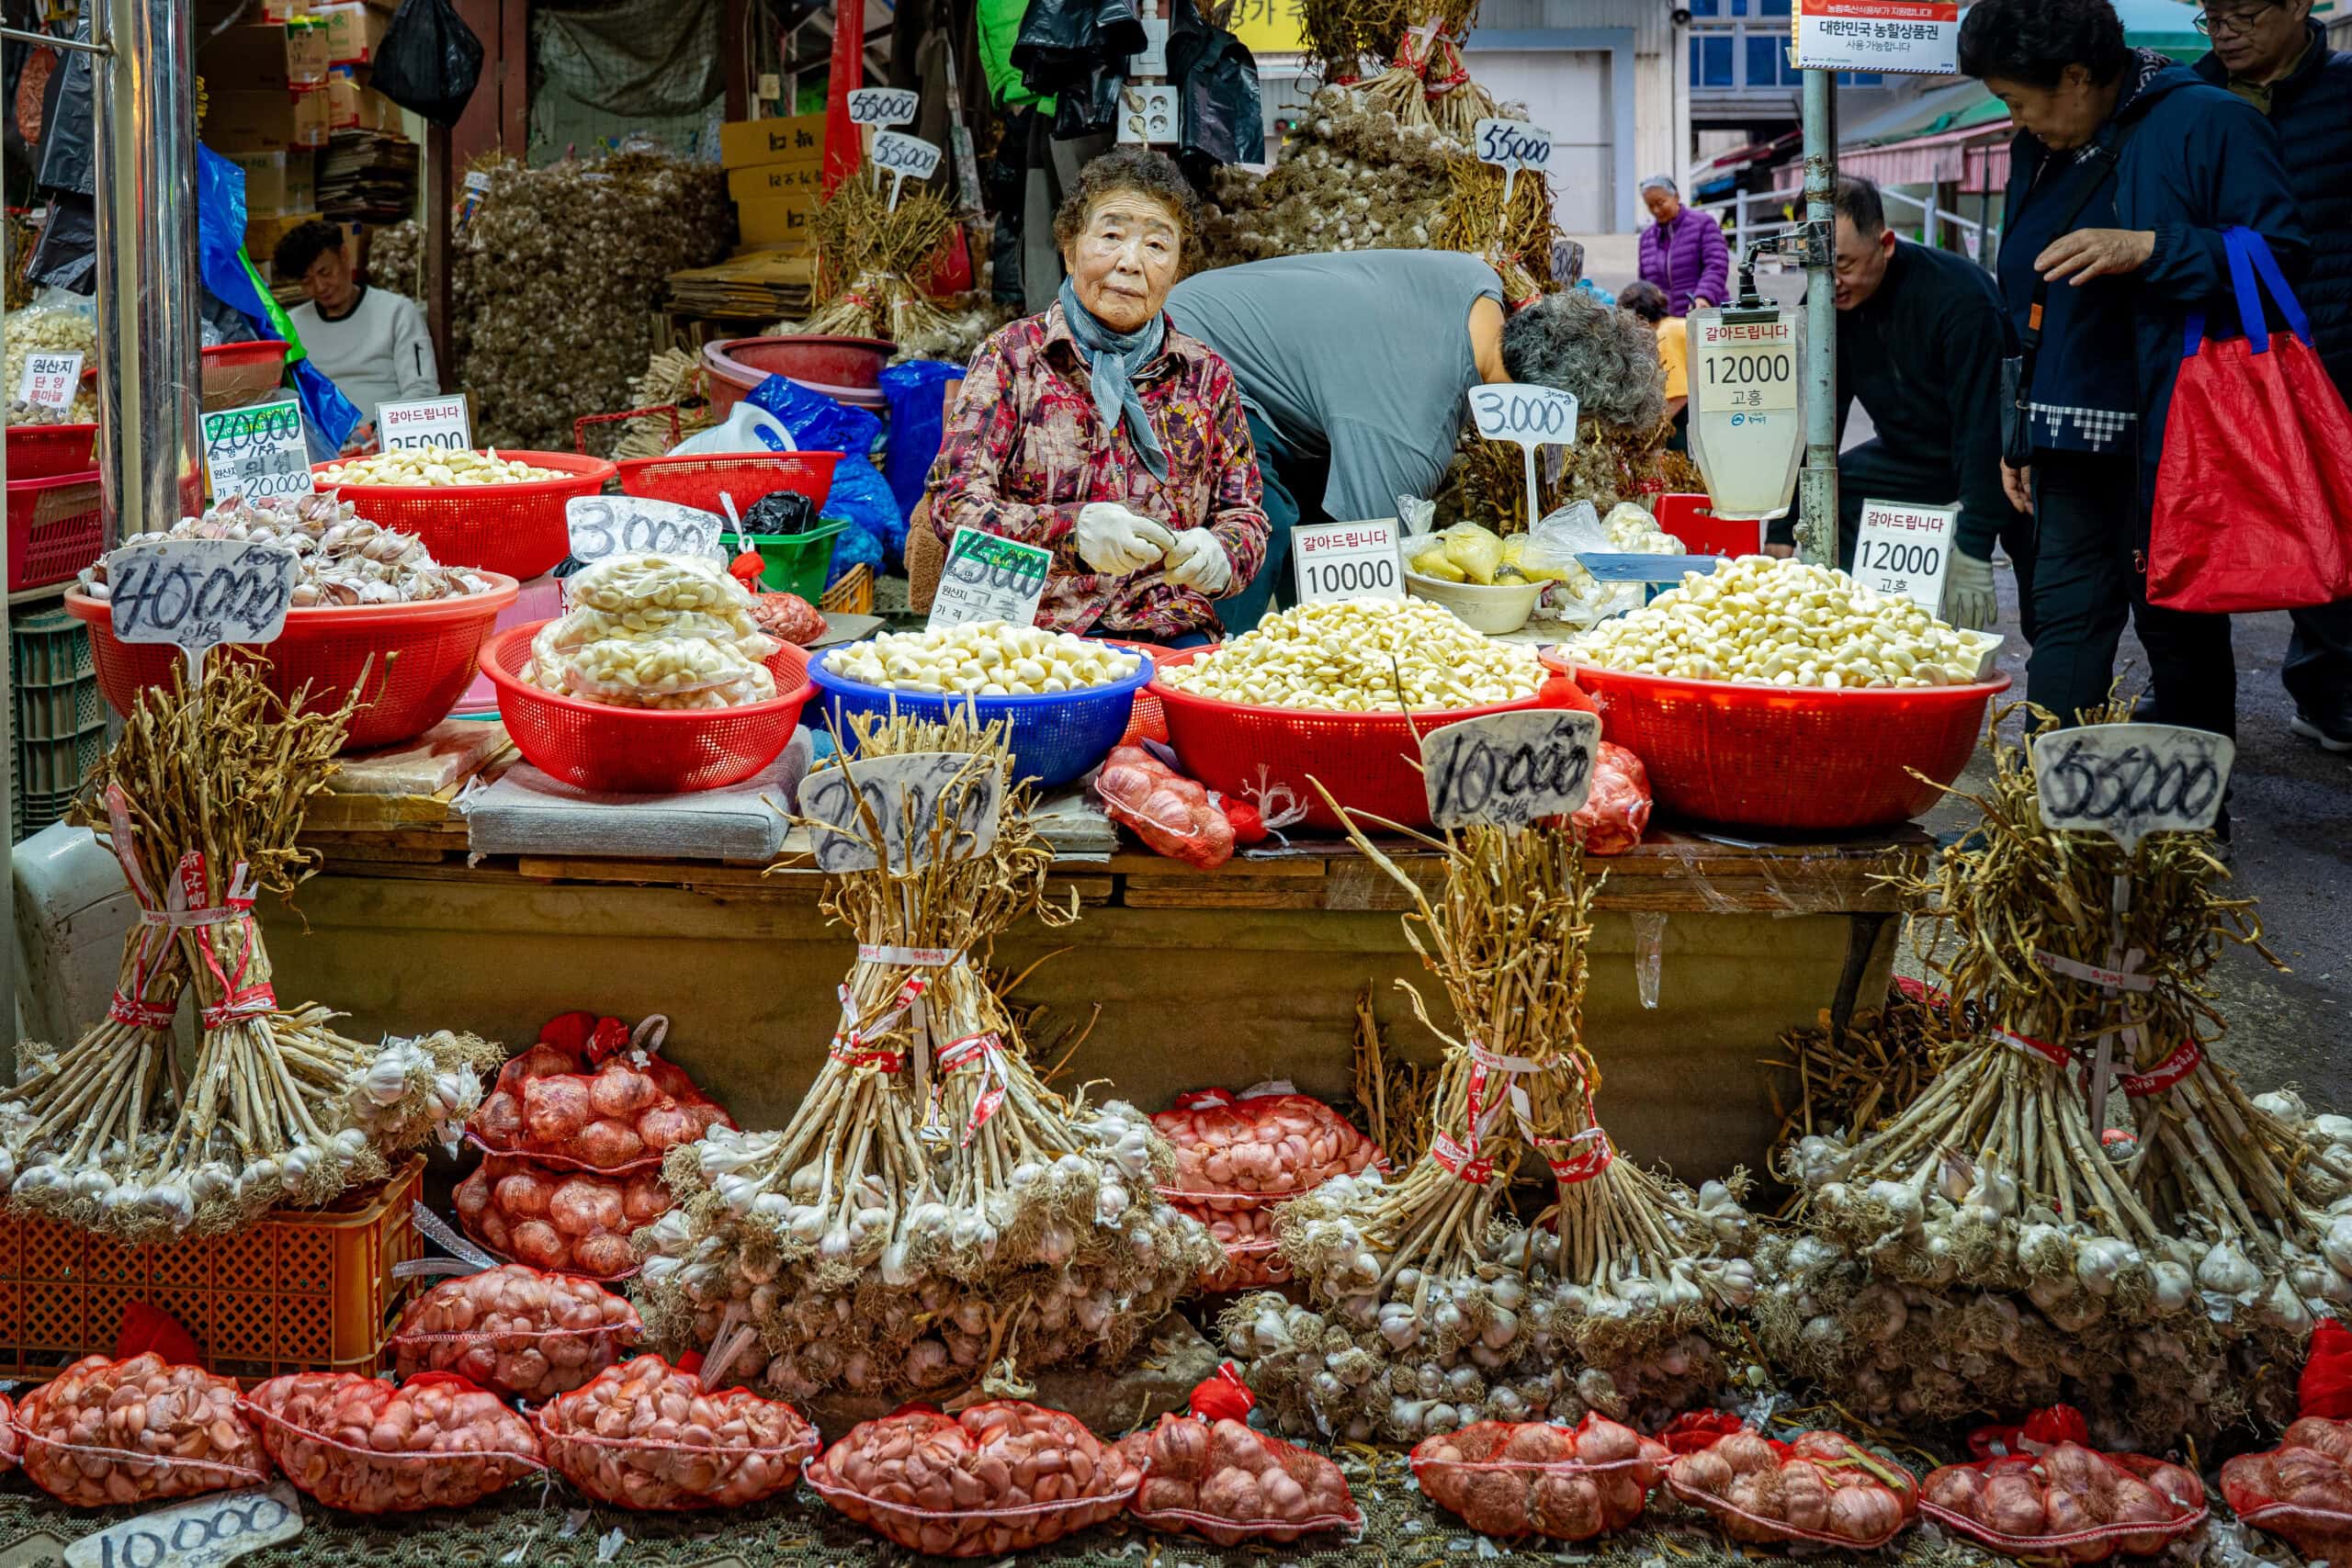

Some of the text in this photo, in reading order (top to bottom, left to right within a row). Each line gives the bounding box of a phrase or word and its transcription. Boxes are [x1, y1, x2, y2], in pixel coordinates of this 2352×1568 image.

[1819, 20, 1939, 40] 대한민국 농할상품권
[1845, 39, 1911, 52] 사용 가능합니다
[1705, 324, 1790, 342] 갈아드립니다
[32, 359, 74, 374] 원산지
[1705, 355, 1790, 384] 12000
[1731, 389, 1763, 407] 고흥
[389, 406, 458, 424] 갈아드립니다
[1868, 512, 1944, 533] 갈아드립니다
[1303, 529, 1387, 552] 갈아드립니다
[1862, 540, 1939, 576] 12000
[1306, 559, 1393, 594] 10000
[941, 585, 968, 601] 원산지
